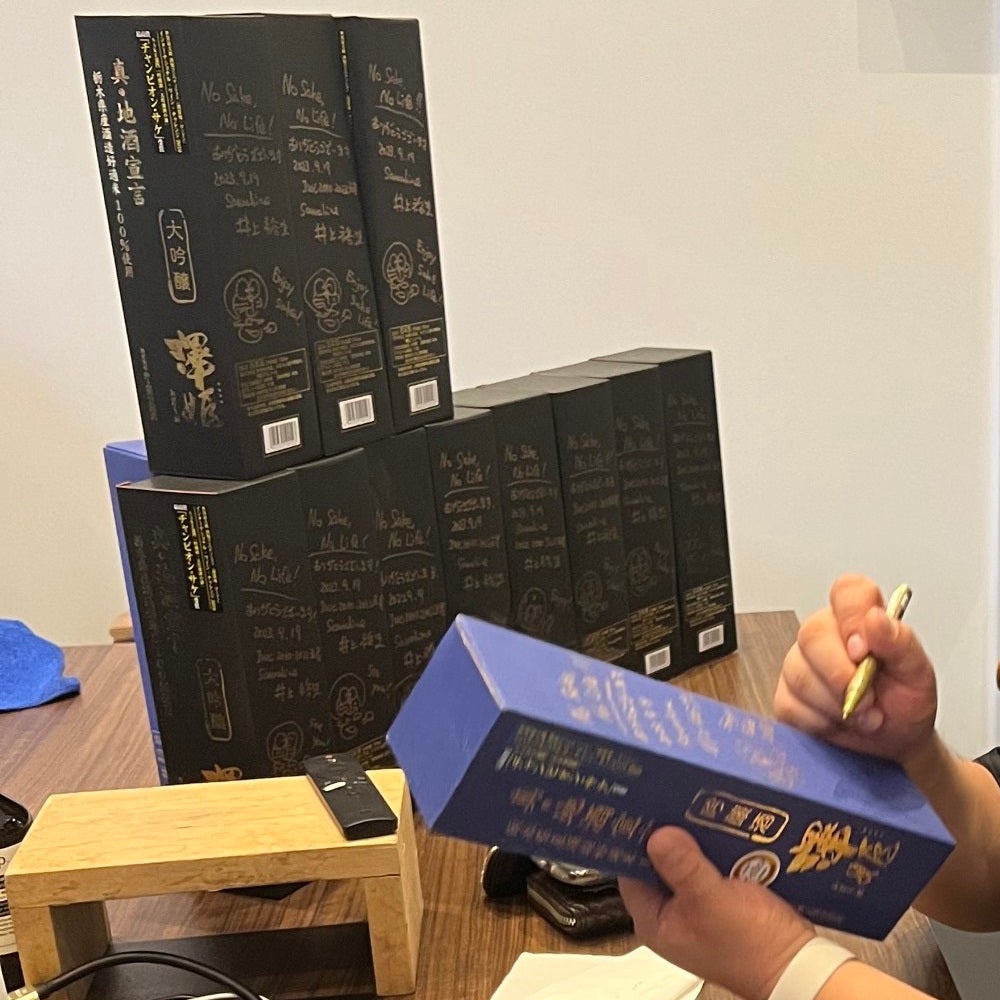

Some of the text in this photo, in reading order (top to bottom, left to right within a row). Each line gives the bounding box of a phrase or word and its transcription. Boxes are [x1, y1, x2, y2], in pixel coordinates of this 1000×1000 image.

[201, 80, 221, 103] No
[282, 73, 298, 96] No
[111, 58, 146, 206] 真・地酒宣言
[220, 112, 237, 130] No
[165, 220, 192, 291] 大吟醸
